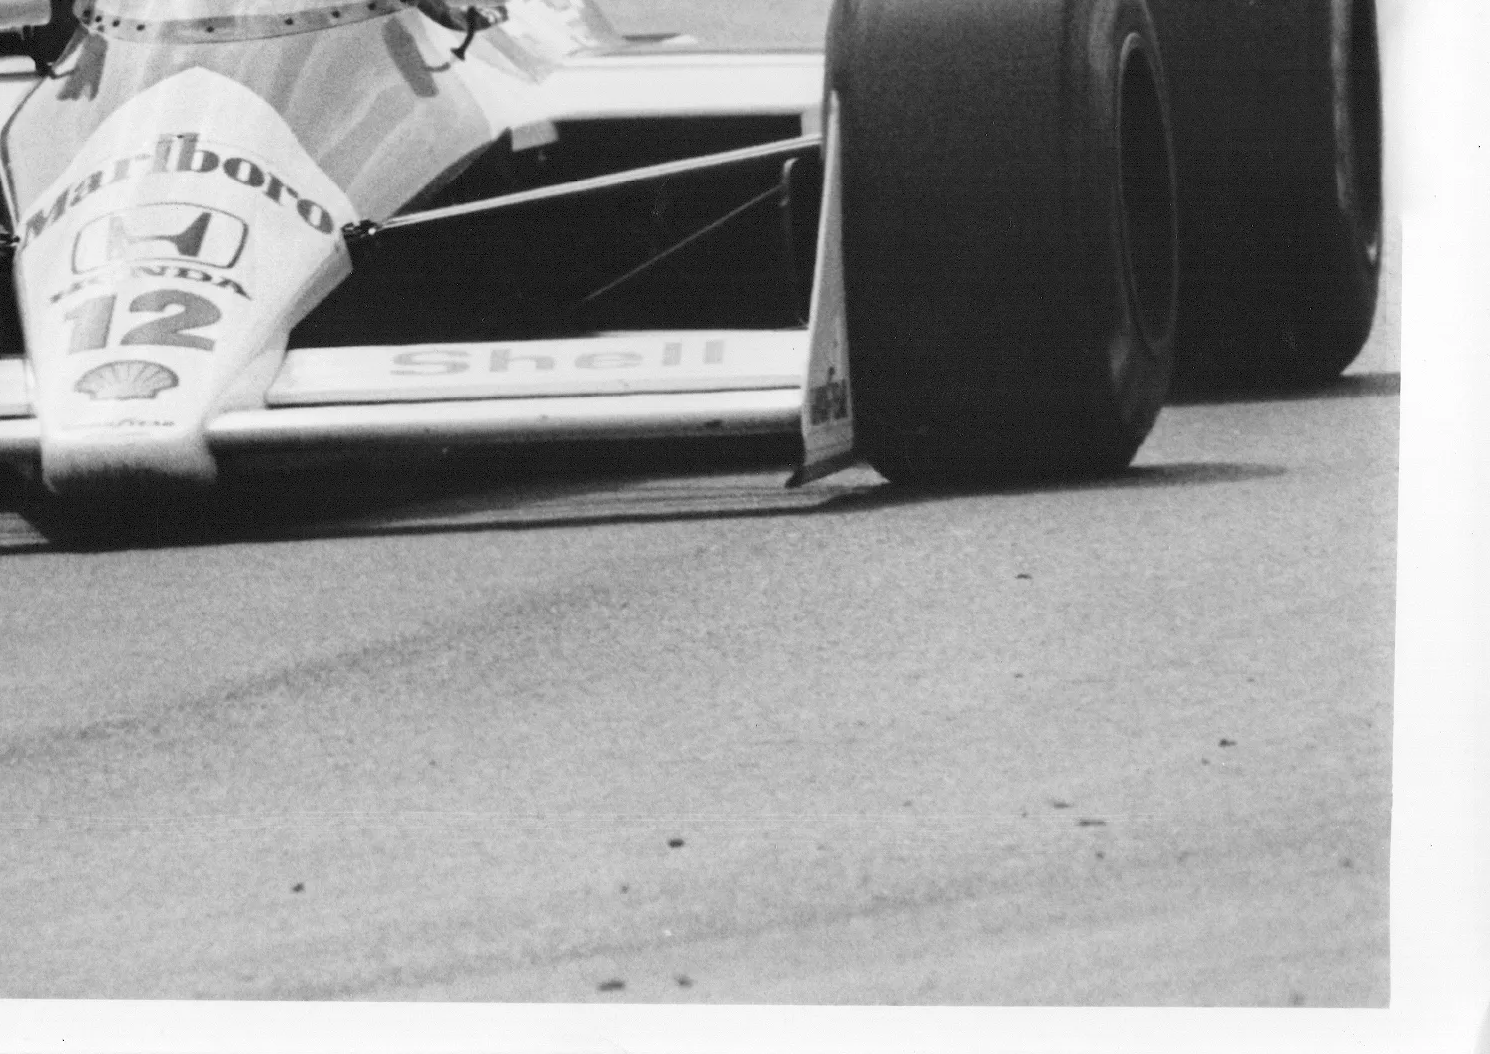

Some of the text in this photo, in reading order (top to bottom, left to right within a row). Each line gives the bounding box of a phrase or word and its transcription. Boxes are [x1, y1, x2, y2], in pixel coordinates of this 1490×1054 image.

[21, 132, 335, 246] Marlboro
[50, 265, 252, 304] HNDA
[64, 288, 222, 355] 12
[390, 339, 725, 377] Shell
